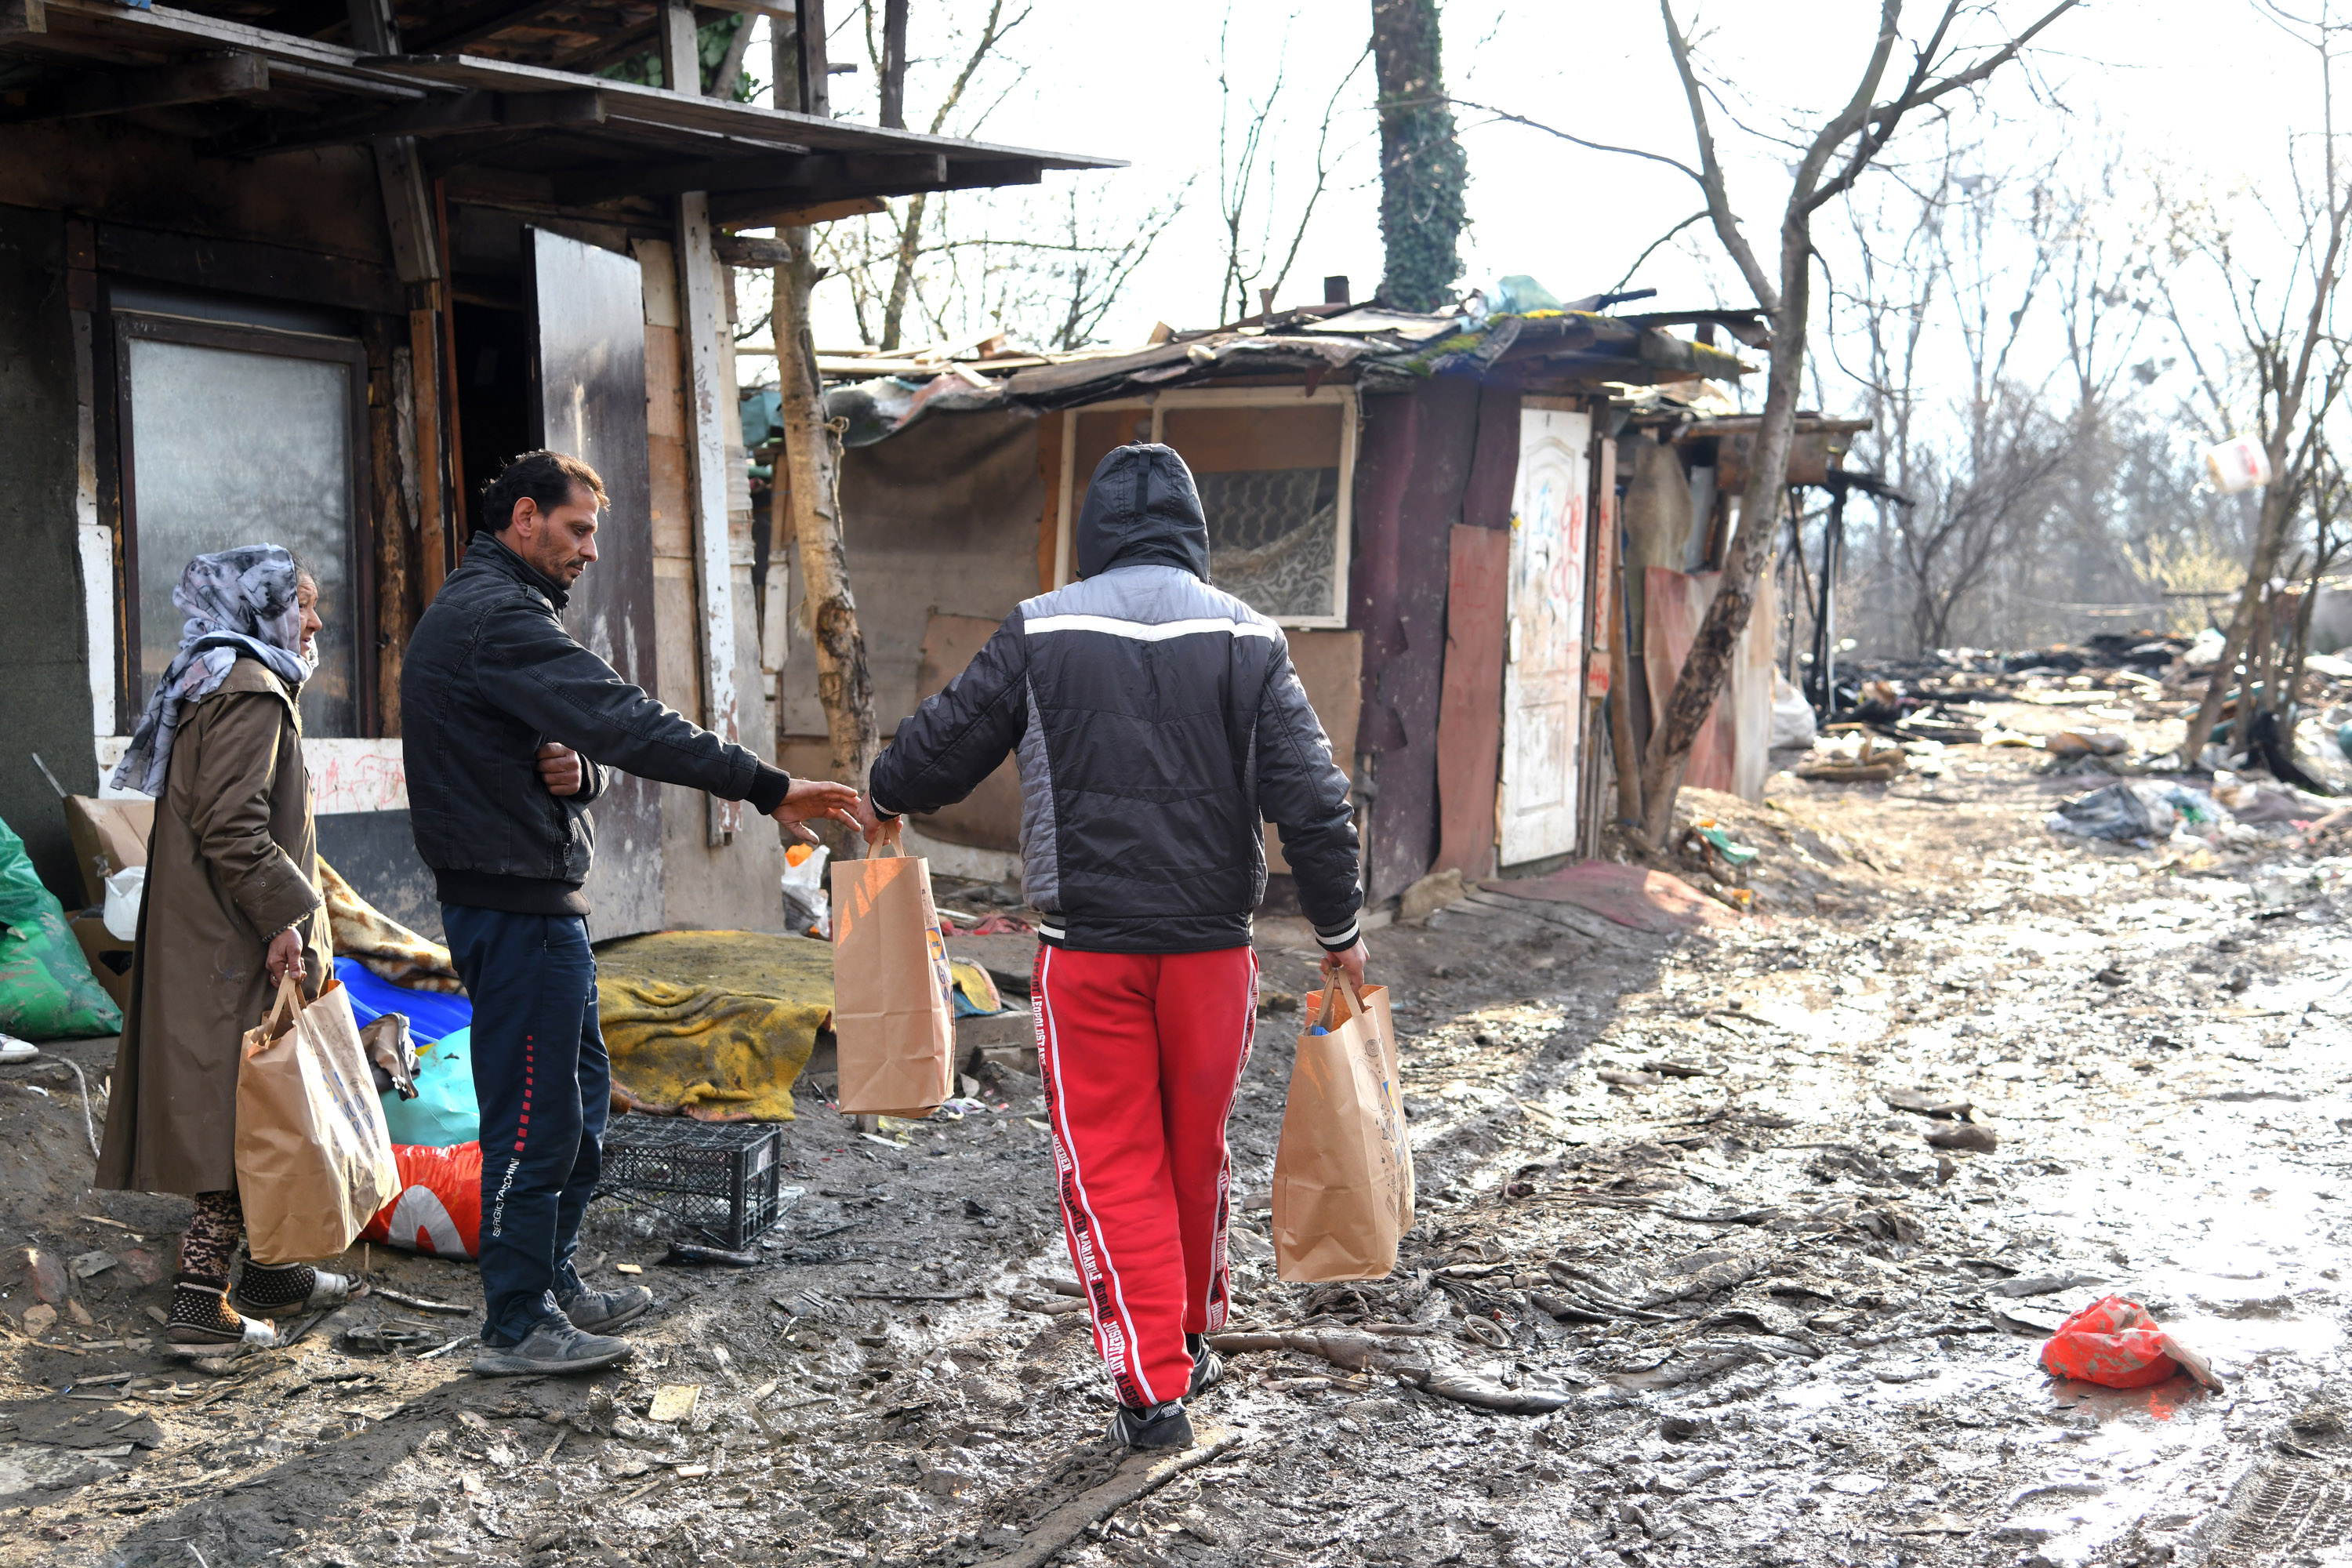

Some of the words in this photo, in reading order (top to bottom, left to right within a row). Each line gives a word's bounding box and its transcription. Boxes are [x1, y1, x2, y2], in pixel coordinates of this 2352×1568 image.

[1053, 1134, 1073, 1172] WIEDEN
[1077, 1230, 1103, 1282] MARIAHILF
[1092, 1280, 1115, 1320] NEUBAU
[1102, 1320, 1128, 1374] JOSEFSTADT
[1160, 1403, 1181, 1414] ARMANI
[1163, 1409, 1180, 1418] JEANS
